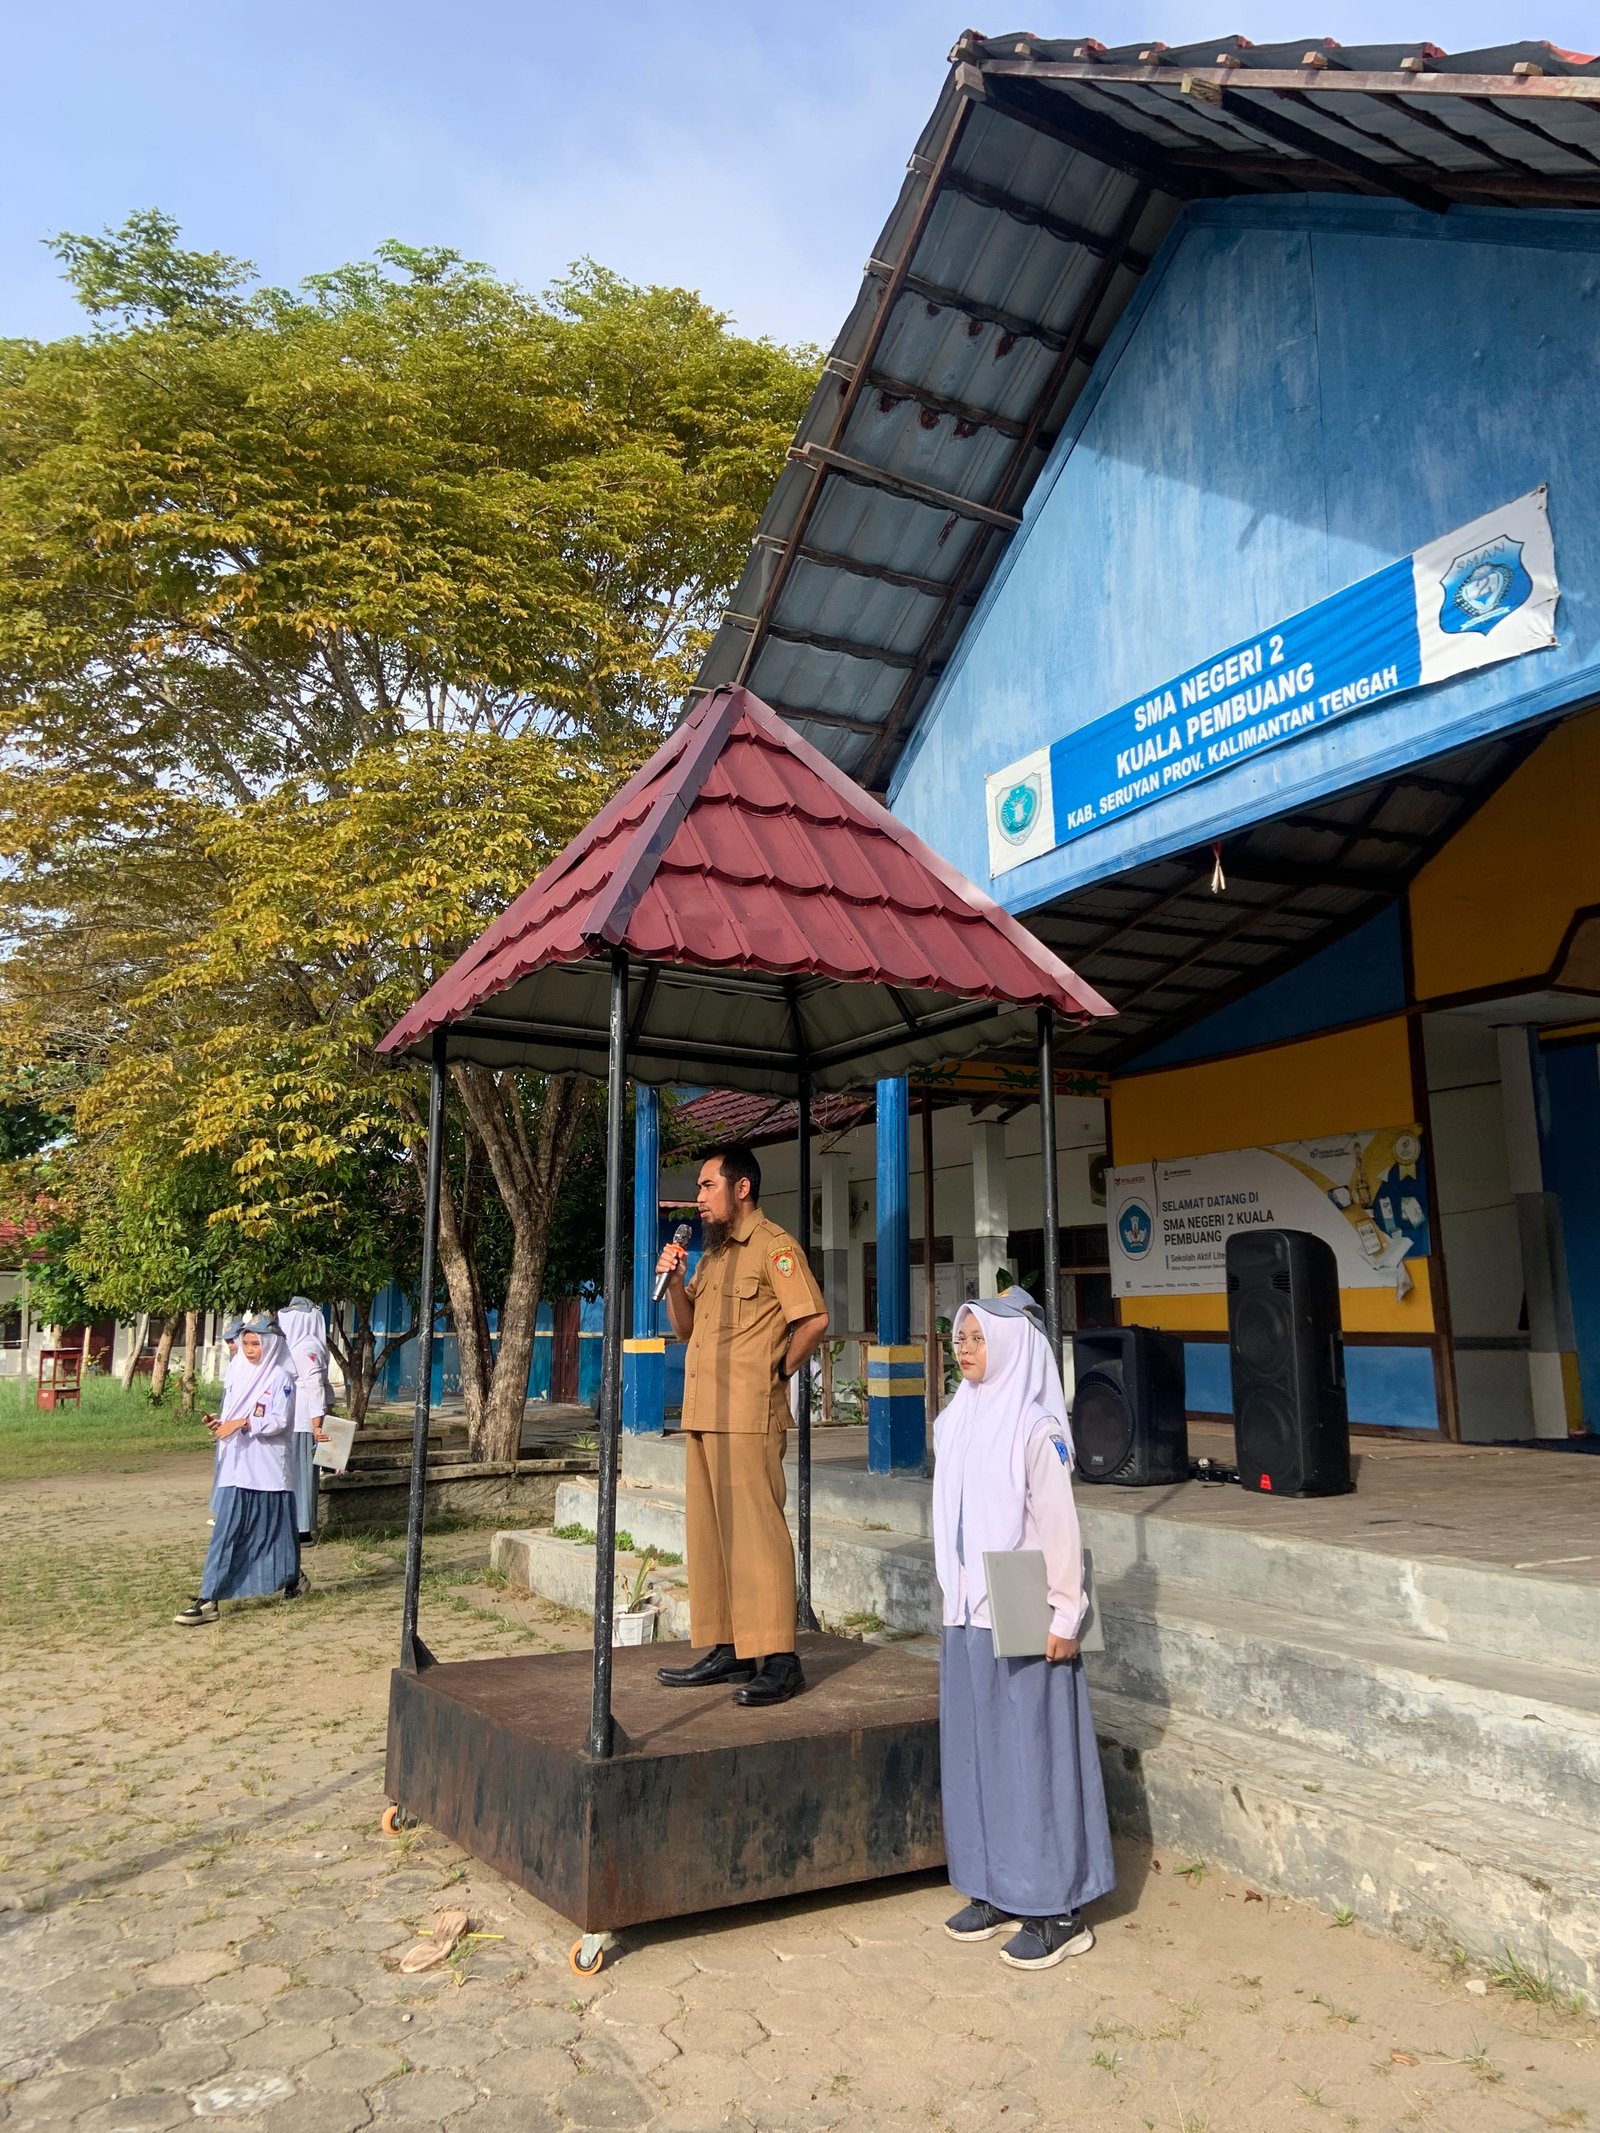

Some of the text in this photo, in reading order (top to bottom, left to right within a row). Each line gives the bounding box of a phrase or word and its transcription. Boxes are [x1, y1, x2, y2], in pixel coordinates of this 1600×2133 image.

[1456, 541, 1506, 574] SMAN
[1133, 634, 1285, 732] SMA NEGERI 2
[1116, 661, 1315, 779] KUALA PEMBUANG
[1067, 664, 1399, 830] KAB. SERUYAN PROV. KALIMANTAN TENGAH
[1162, 1191, 1259, 1213] SELAMAT DATANG DI
[1163, 1209, 1275, 1231] SMA NEGERI 2 KUALA
[1164, 1230, 1222, 1246] PEMBUANG
[1170, 1252, 1196, 1263] Sekolah
[1196, 1250, 1212, 1261] Aktif
